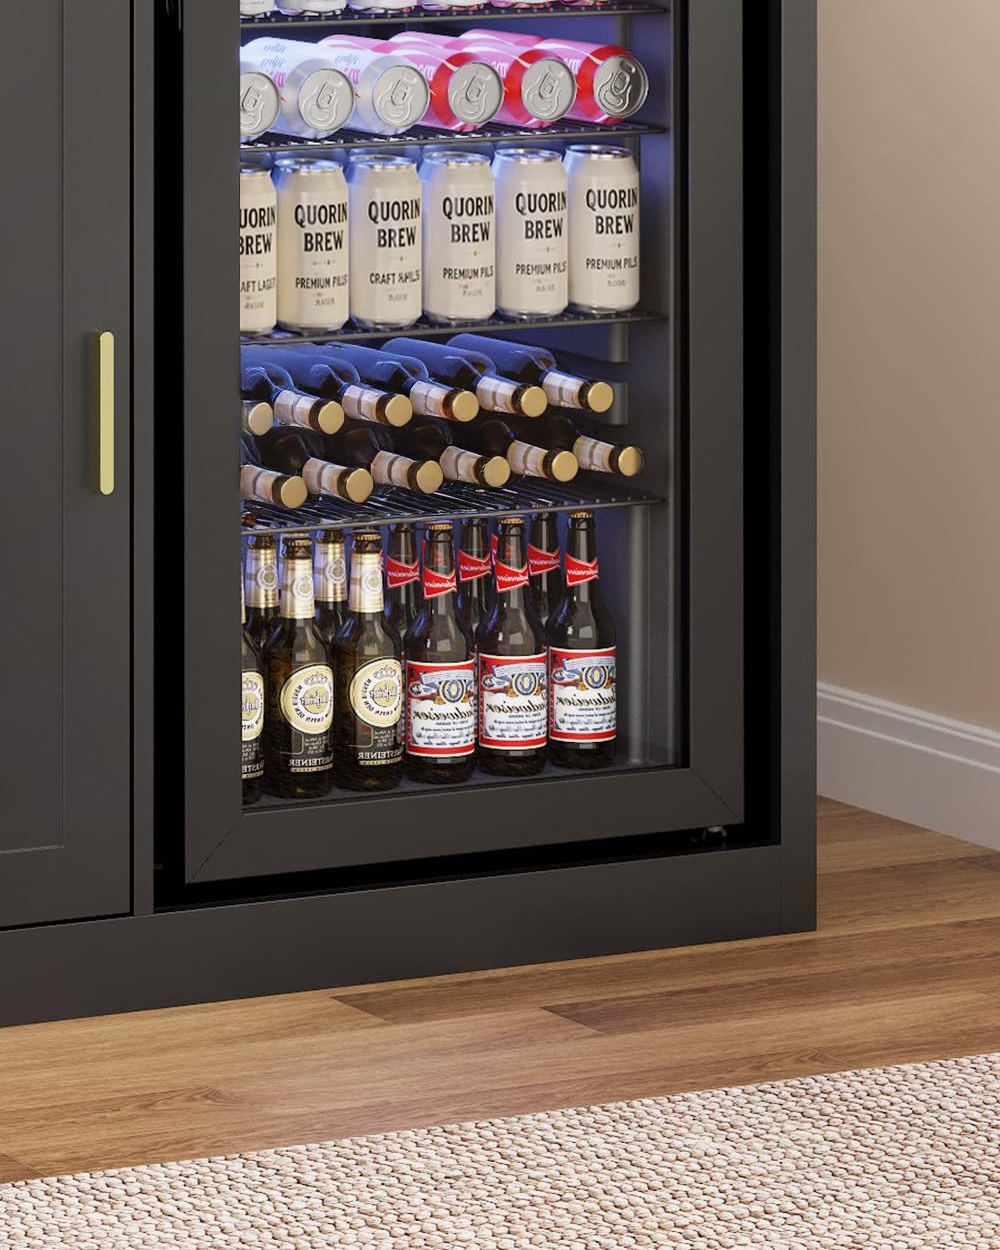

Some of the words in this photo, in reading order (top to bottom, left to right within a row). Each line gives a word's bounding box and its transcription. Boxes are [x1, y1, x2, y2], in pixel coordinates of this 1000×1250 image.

[442, 194, 494, 220] QUORIN
[515, 190, 567, 215] QUORIN
[586, 187, 638, 212] QUORIN
[240, 205, 276, 228] UORIN
[294, 202, 347, 229] QUORIN
[368, 198, 420, 224] QUORIN
[451, 221, 490, 243] BREW
[525, 218, 563, 239] BREW
[595, 214, 634, 235] BREW
[304, 230, 344, 252] BREW
[377, 226, 416, 248] BREW
[443, 267, 479, 280] PREMIUM
[515, 263, 551, 275] PREMIUM
[586, 257, 622, 270] PREMIUM
[295, 276, 331, 290] PREMIUM
[369, 272, 396, 285] CRAFT
